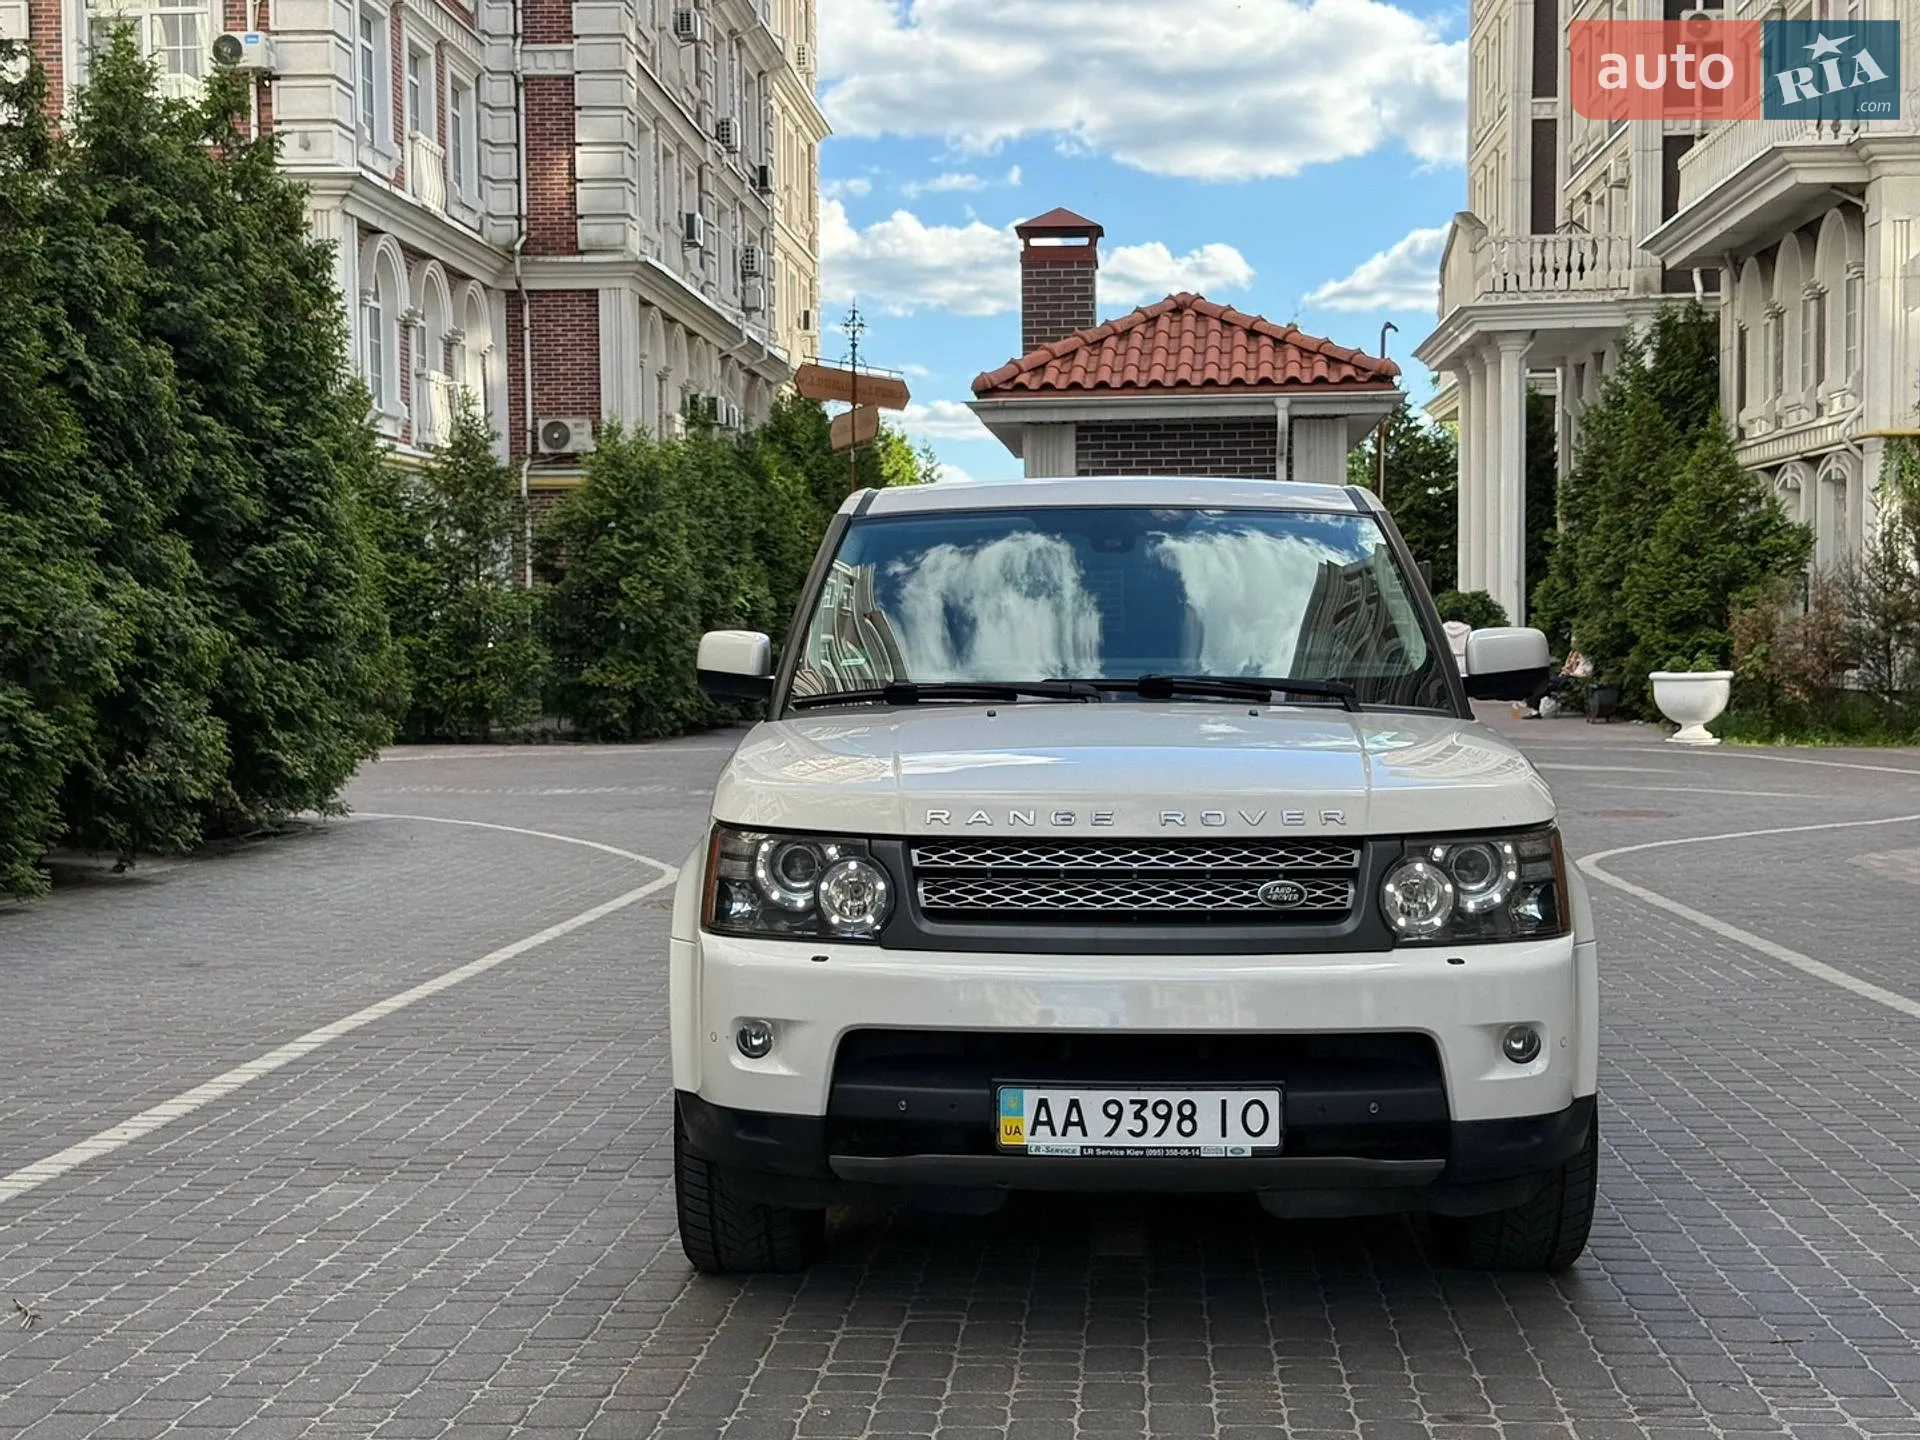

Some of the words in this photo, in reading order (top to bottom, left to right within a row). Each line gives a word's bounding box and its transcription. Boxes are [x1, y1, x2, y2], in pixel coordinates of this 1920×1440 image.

[926, 809, 1115, 827] RANGE
[1159, 809, 1347, 827] ROVER
[1029, 1098, 1088, 1138] AA
[1103, 1098, 1198, 1138] 9398
[1220, 1098, 1270, 1138] IO
[1004, 1125, 1023, 1137] UA
[1083, 1147, 1095, 1156] LR
[1096, 1147, 1126, 1156] Service
